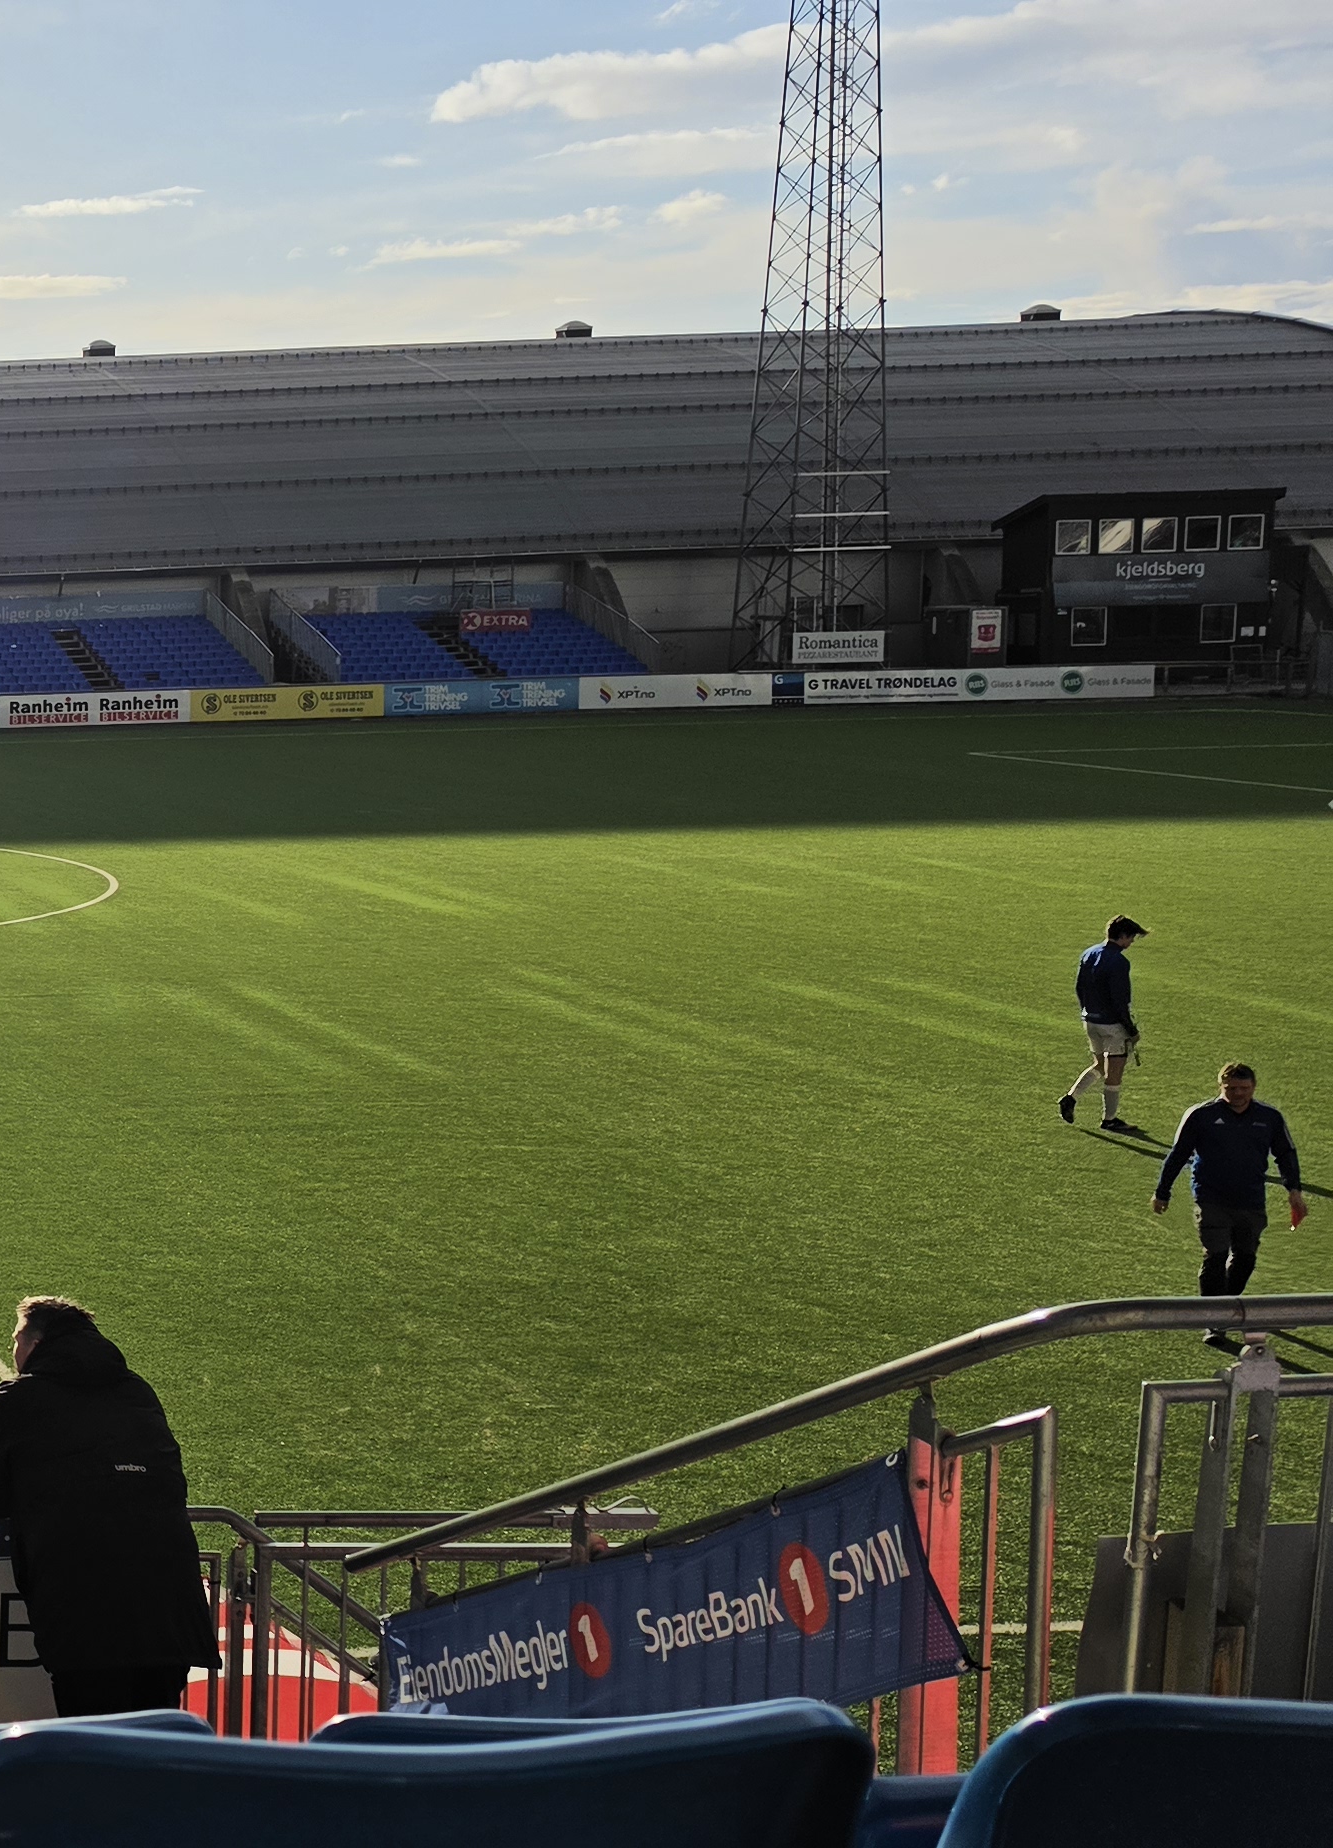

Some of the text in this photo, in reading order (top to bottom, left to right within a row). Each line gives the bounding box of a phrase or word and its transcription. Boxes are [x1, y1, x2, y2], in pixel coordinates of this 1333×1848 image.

[1116, 561, 1205, 579] kjeldsberg
[36, 604, 51, 622] på
[483, 616, 528, 627] EXTRA
[798, 635, 879, 650] Romantica
[425, 685, 448, 693] TRIM
[522, 681, 546, 690] TRIM
[808, 677, 958, 690] G TRAVEL TRØNDELAG
[224, 694, 277, 704] OLE SIVERTSEN
[321, 691, 374, 701] OLE SIVERTSEN
[424, 692, 468, 702] TRENING
[522, 689, 565, 699] TRENING
[9, 697, 88, 715] Ranheim
[99, 694, 178, 712] Ranheim
[10, 713, 88, 725] BILSERVICE
[100, 711, 178, 722] BILSERVICE
[115, 1463, 147, 1474] umbro
[636, 1524, 910, 1662] SpareBank 1 SMN
[397, 1614, 600, 1703] EiendomsMegler 1
